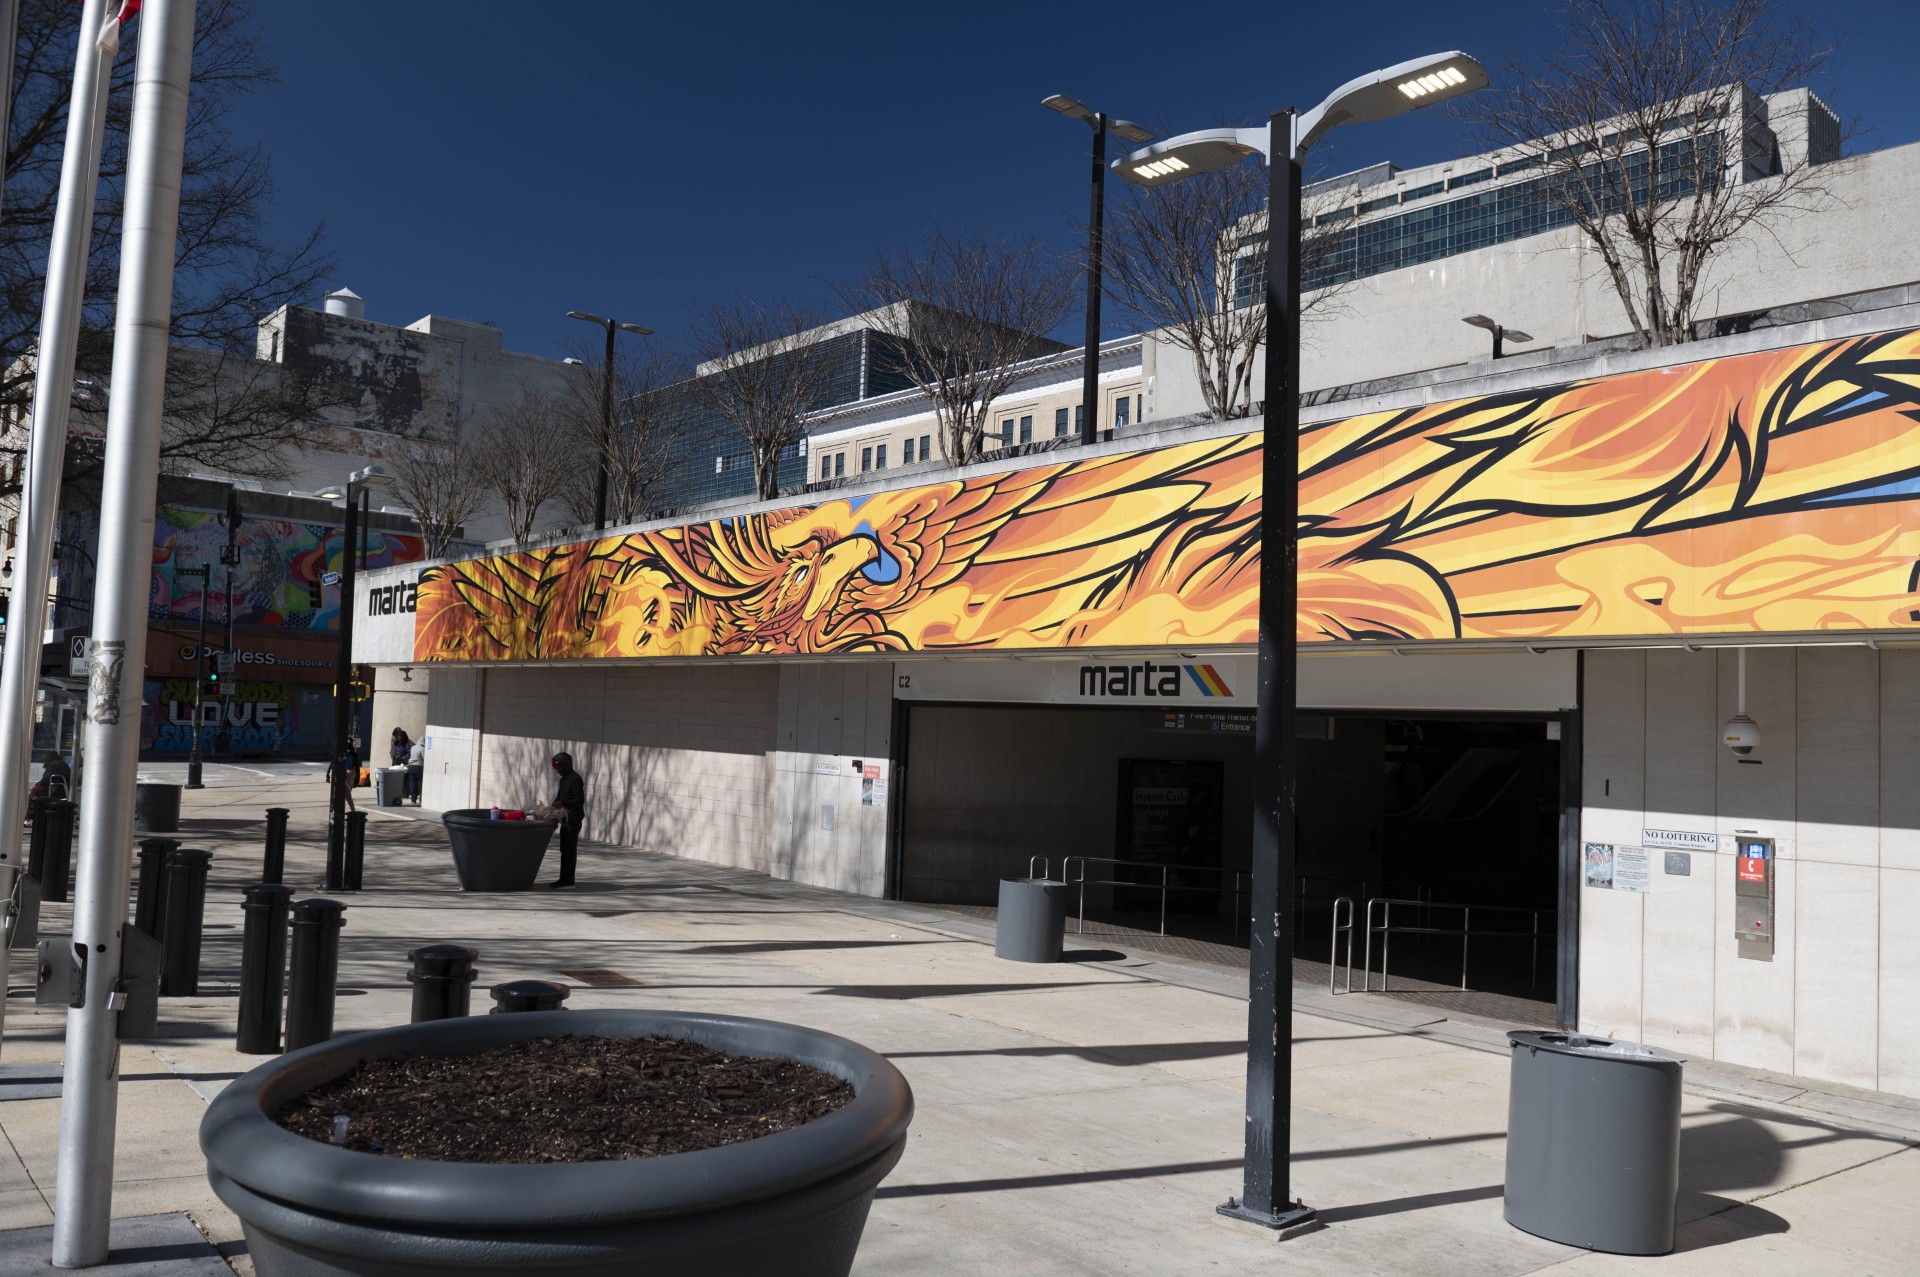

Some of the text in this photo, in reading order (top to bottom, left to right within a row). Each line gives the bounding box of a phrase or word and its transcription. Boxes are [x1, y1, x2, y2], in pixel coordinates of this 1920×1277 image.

[369, 580, 417, 616] marta
[276, 658, 334, 669] SHOESOURCE
[899, 675, 911, 689] C2
[1080, 661, 1181, 696] marta
[169, 700, 279, 727] LOVE
[1220, 721, 1251, 732] Entrance
[1135, 790, 1186, 803] Instant Cash
[1645, 830, 1715, 843] NO LOITERING
